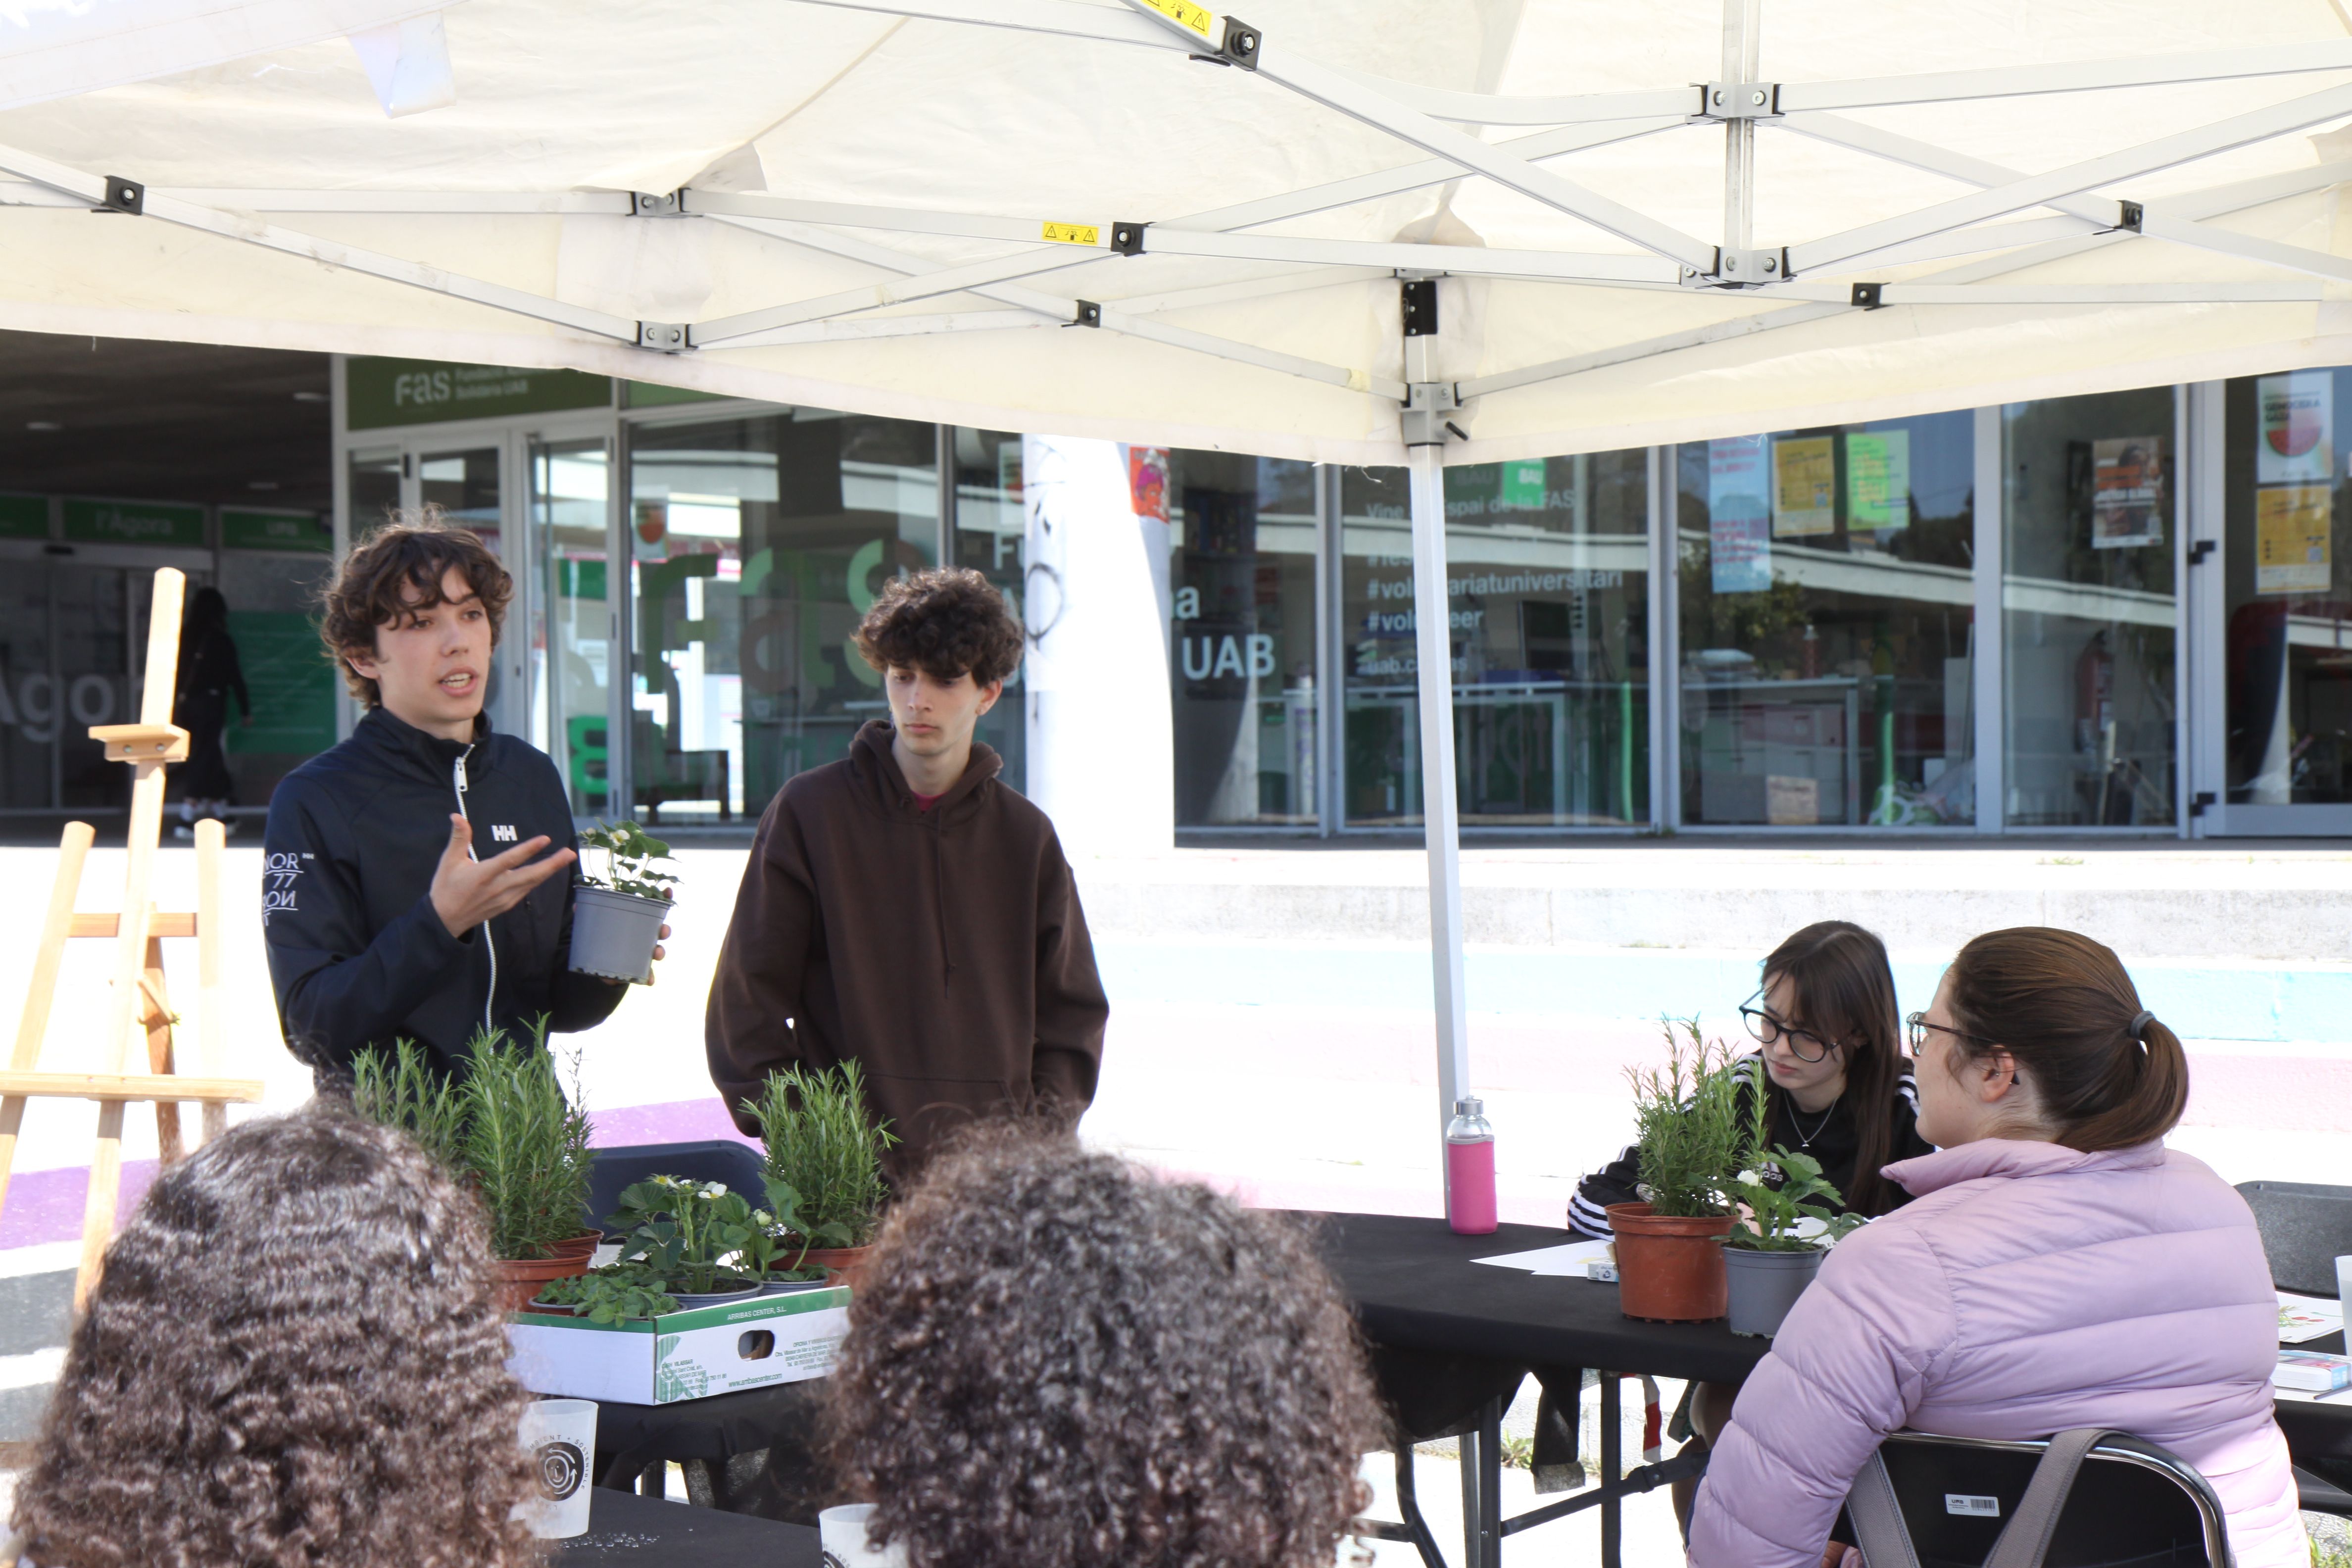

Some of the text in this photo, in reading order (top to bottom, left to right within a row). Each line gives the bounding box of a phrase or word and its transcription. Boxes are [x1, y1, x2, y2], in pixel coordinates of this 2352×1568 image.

[1182, 634, 1275, 681] UAB
[491, 825, 518, 841] HH
[728, 1311, 752, 1321] ARRIBAS
[753, 1307, 776, 1317] CENTER,
[530, 1434, 562, 1451] MBIENT
